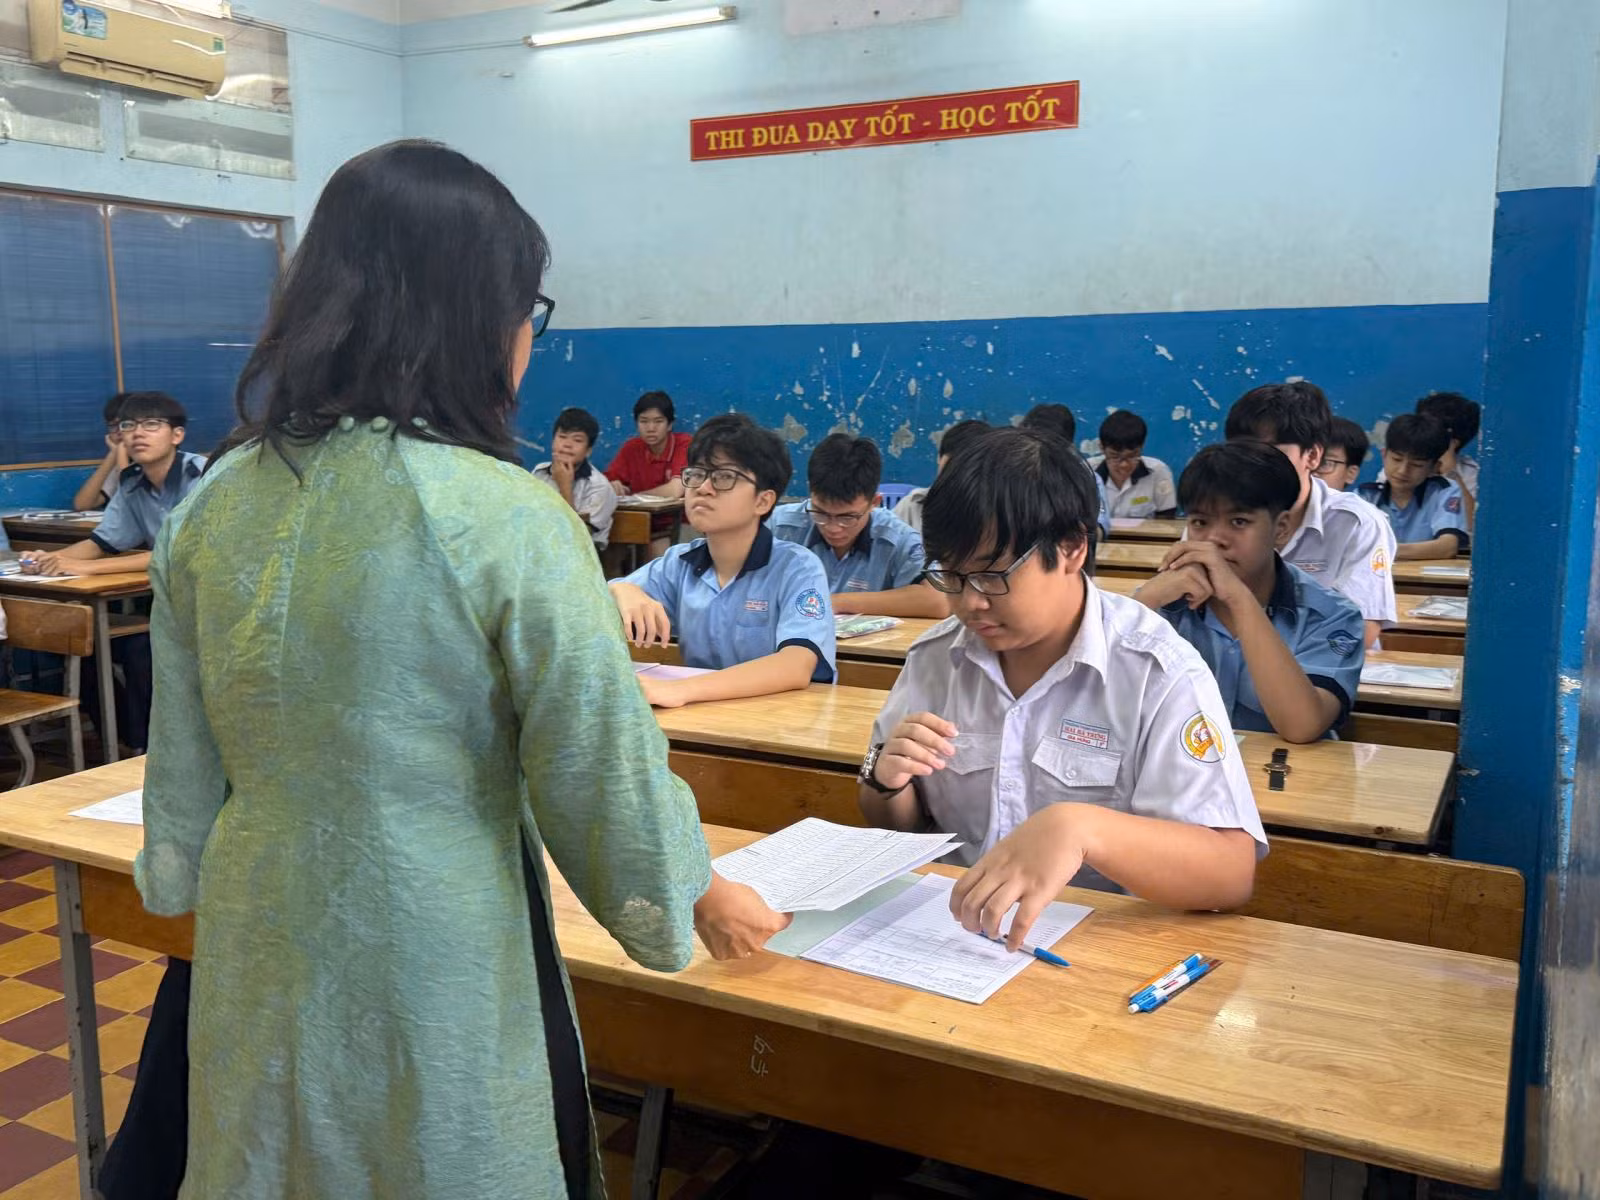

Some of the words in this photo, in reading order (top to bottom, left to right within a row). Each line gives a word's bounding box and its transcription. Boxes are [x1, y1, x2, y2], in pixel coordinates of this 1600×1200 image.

[705, 129, 745, 150] THI
[752, 124, 800, 147] ĐUA
[807, 118, 858, 145] DẠY
[865, 105, 915, 137] TỐT
[939, 105, 996, 133] HỌC
[1005, 89, 1061, 124] TỐT
